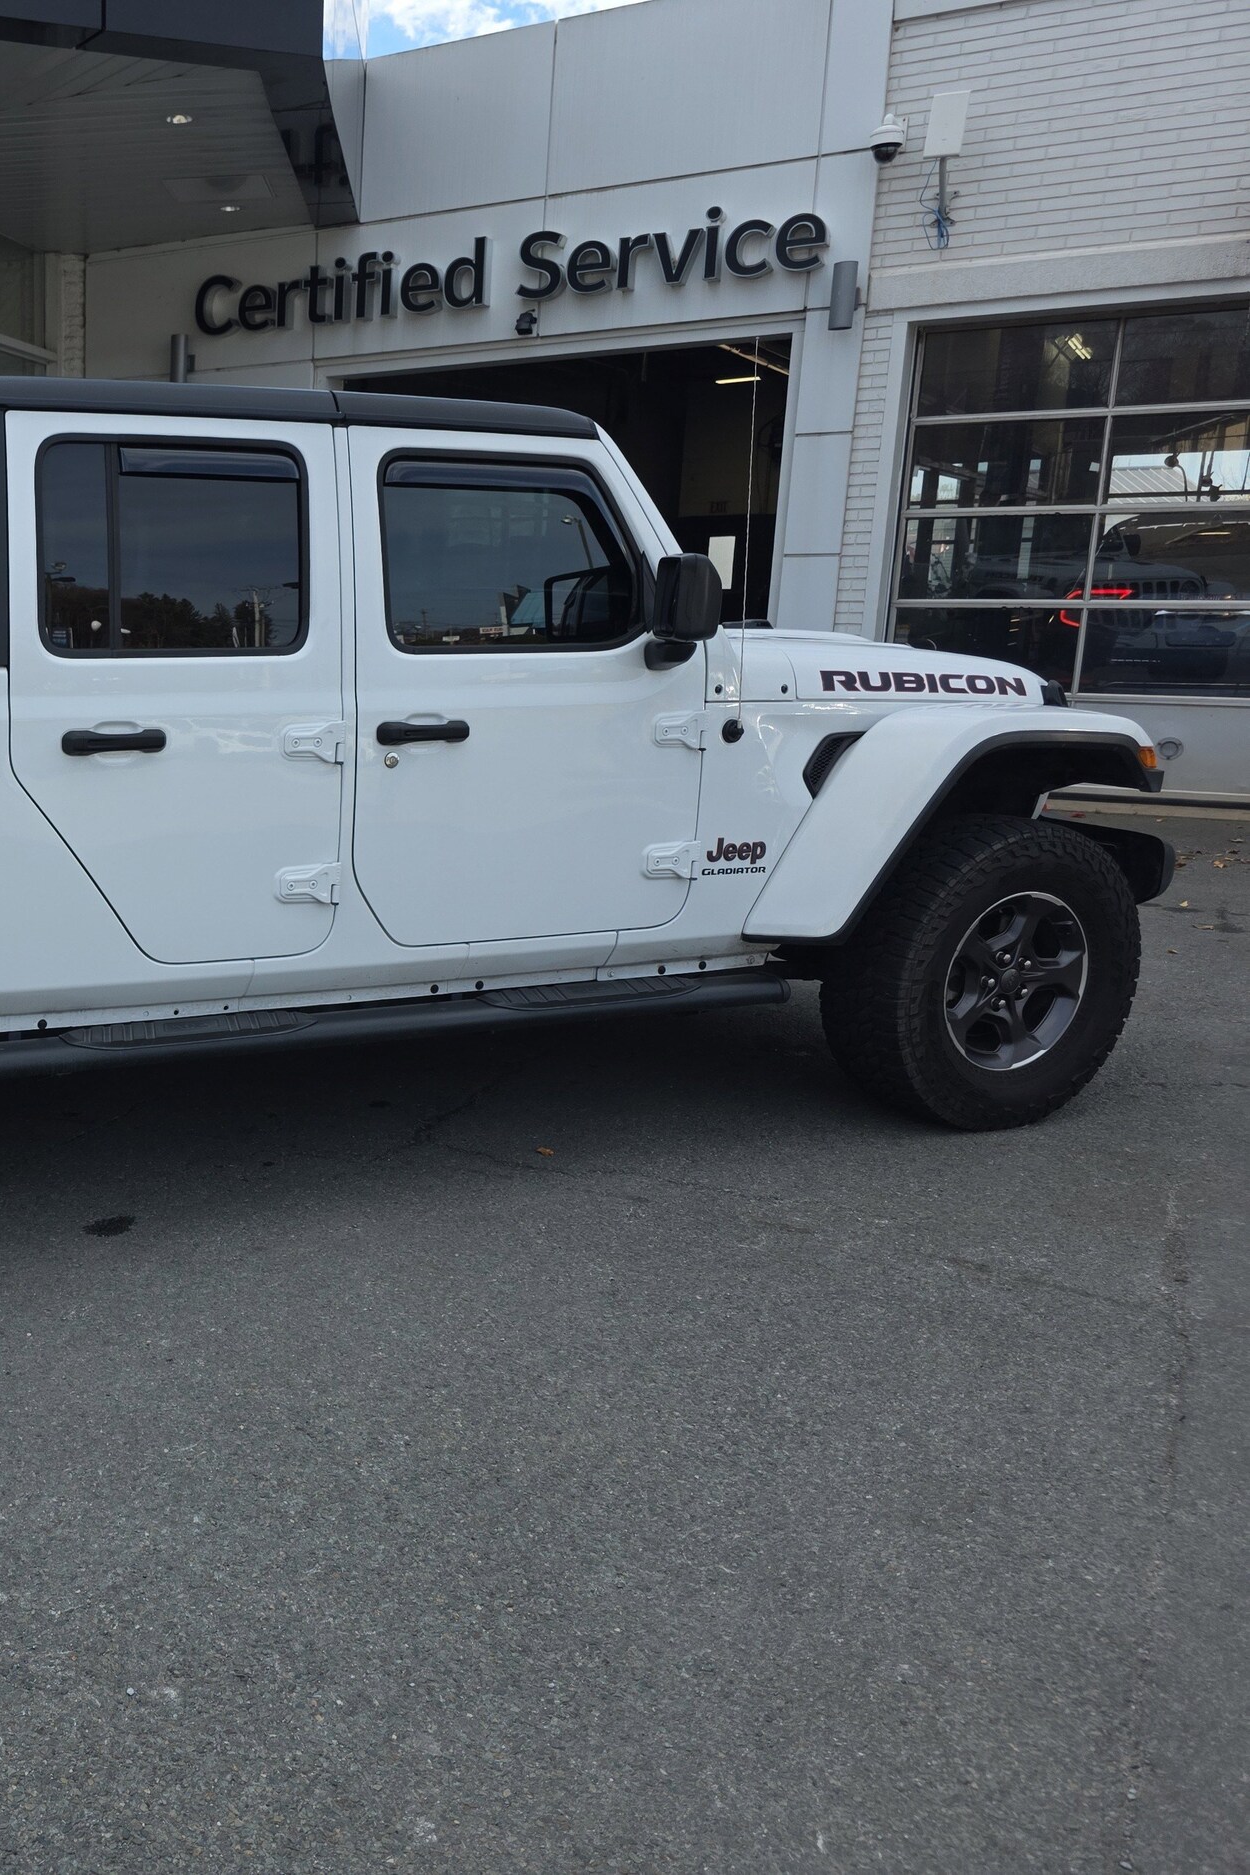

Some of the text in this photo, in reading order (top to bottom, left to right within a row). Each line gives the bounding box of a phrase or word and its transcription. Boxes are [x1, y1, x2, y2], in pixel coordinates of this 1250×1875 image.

[195, 205, 830, 337] Certified Service
[820, 671, 1027, 696] RUBICON
[707, 837, 766, 864] Jeep
[702, 866, 766, 876] GLADIATOR
